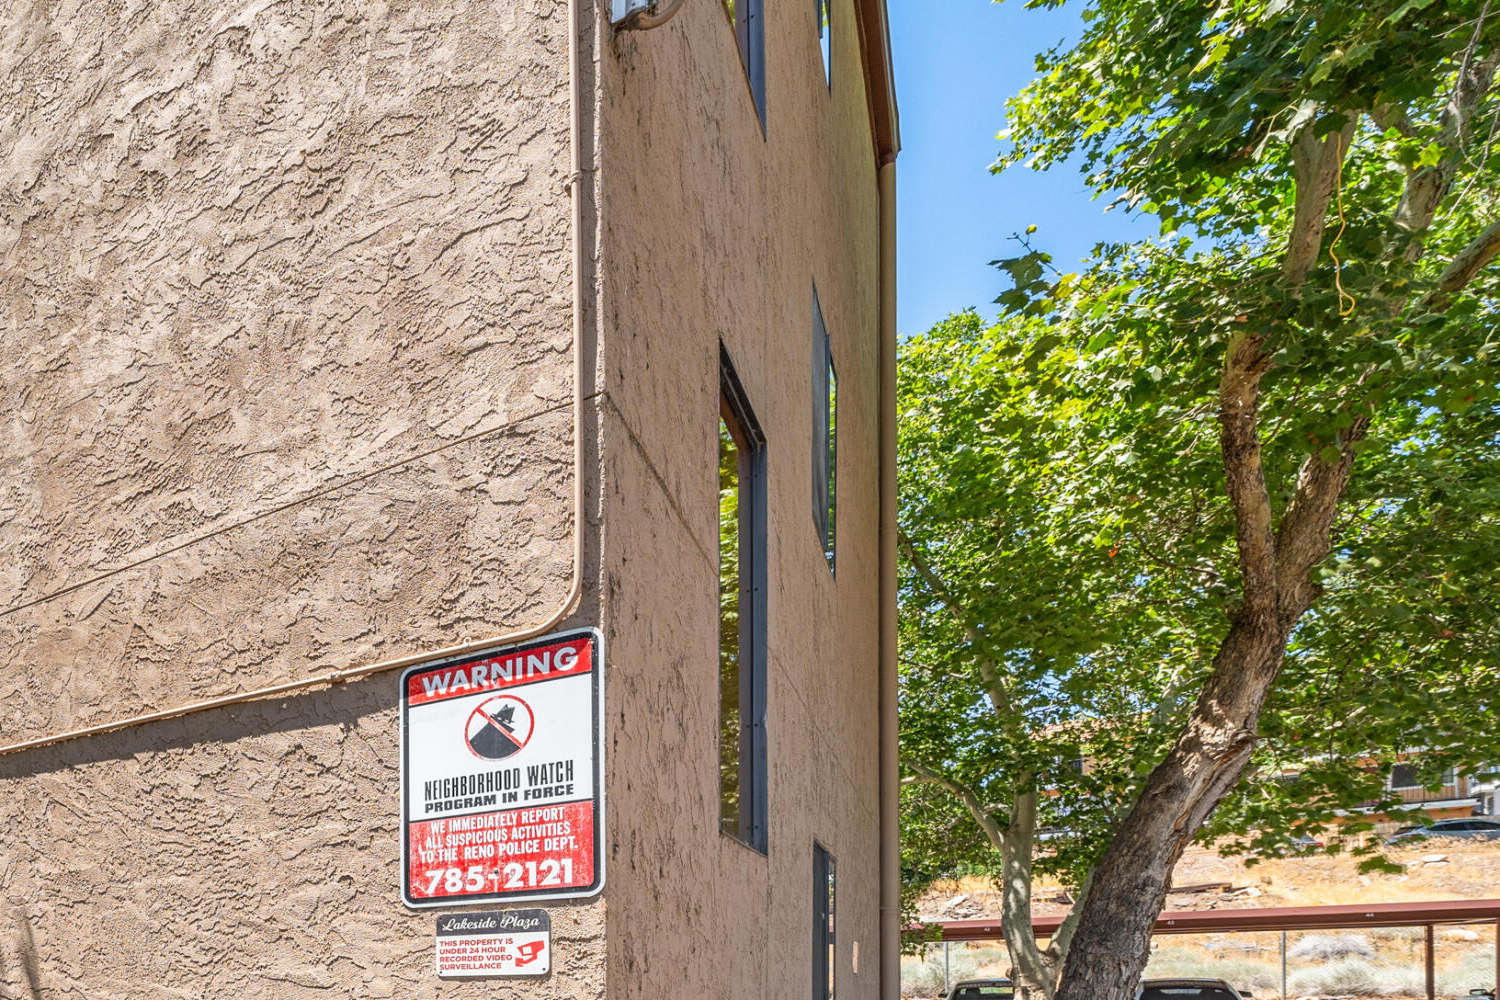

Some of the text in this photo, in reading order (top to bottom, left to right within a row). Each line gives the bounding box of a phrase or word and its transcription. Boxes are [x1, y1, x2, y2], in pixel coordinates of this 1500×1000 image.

[421, 646, 578, 698] WARNING
[424, 759, 574, 801] NEIGHBORHOOD WATCH
[424, 784, 574, 814] PROGRAM IN FORCE
[430, 806, 565, 834] WE IMMEDIATELY REPORT
[420, 836, 579, 863] TO THE RENO POLICE DEPT.
[425, 821, 571, 850] ALL SUSPICIOUS ACTIVITIES
[425, 858, 573, 895] 785-2121
[442, 915, 540, 931] Lakeside Plaza
[459, 938, 503, 946] PROPERTY
[440, 962, 502, 970] SURVEILLANCE
